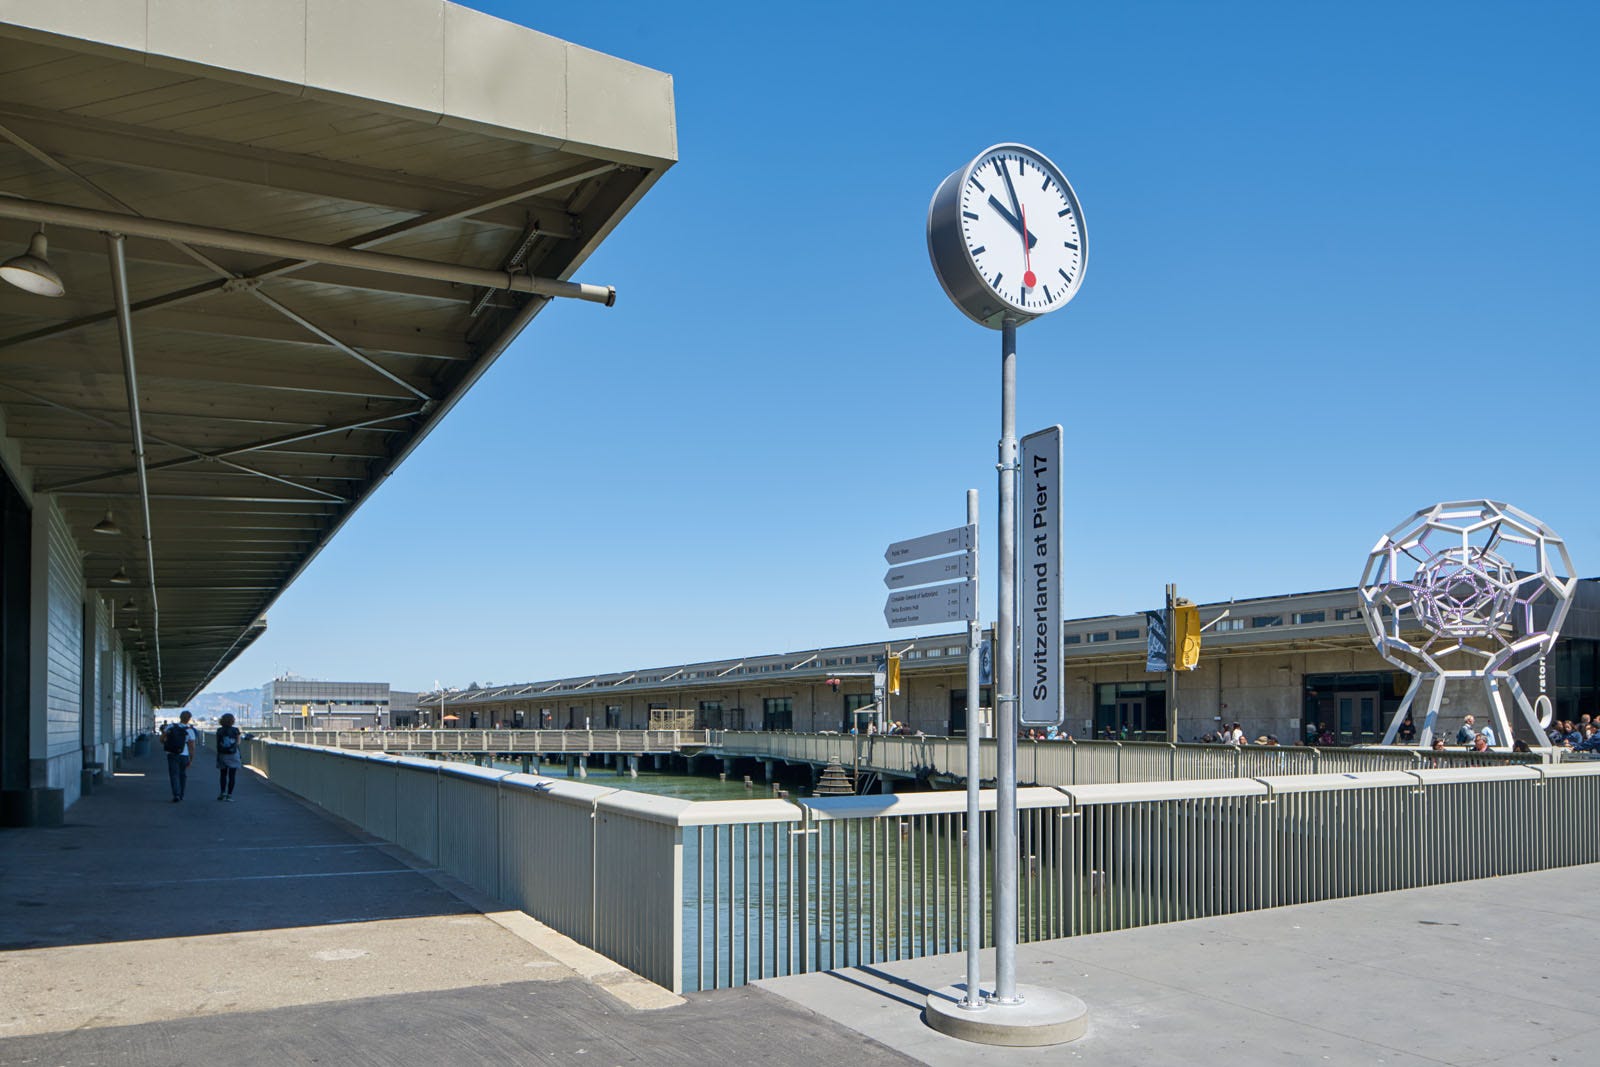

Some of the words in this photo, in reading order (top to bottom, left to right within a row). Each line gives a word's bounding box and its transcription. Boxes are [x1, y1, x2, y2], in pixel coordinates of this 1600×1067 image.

[1034, 454, 1048, 479] 17
[1034, 482, 1048, 529] Pier
[1034, 533, 1048, 557] at
[1033, 562, 1048, 701] Switzerland
